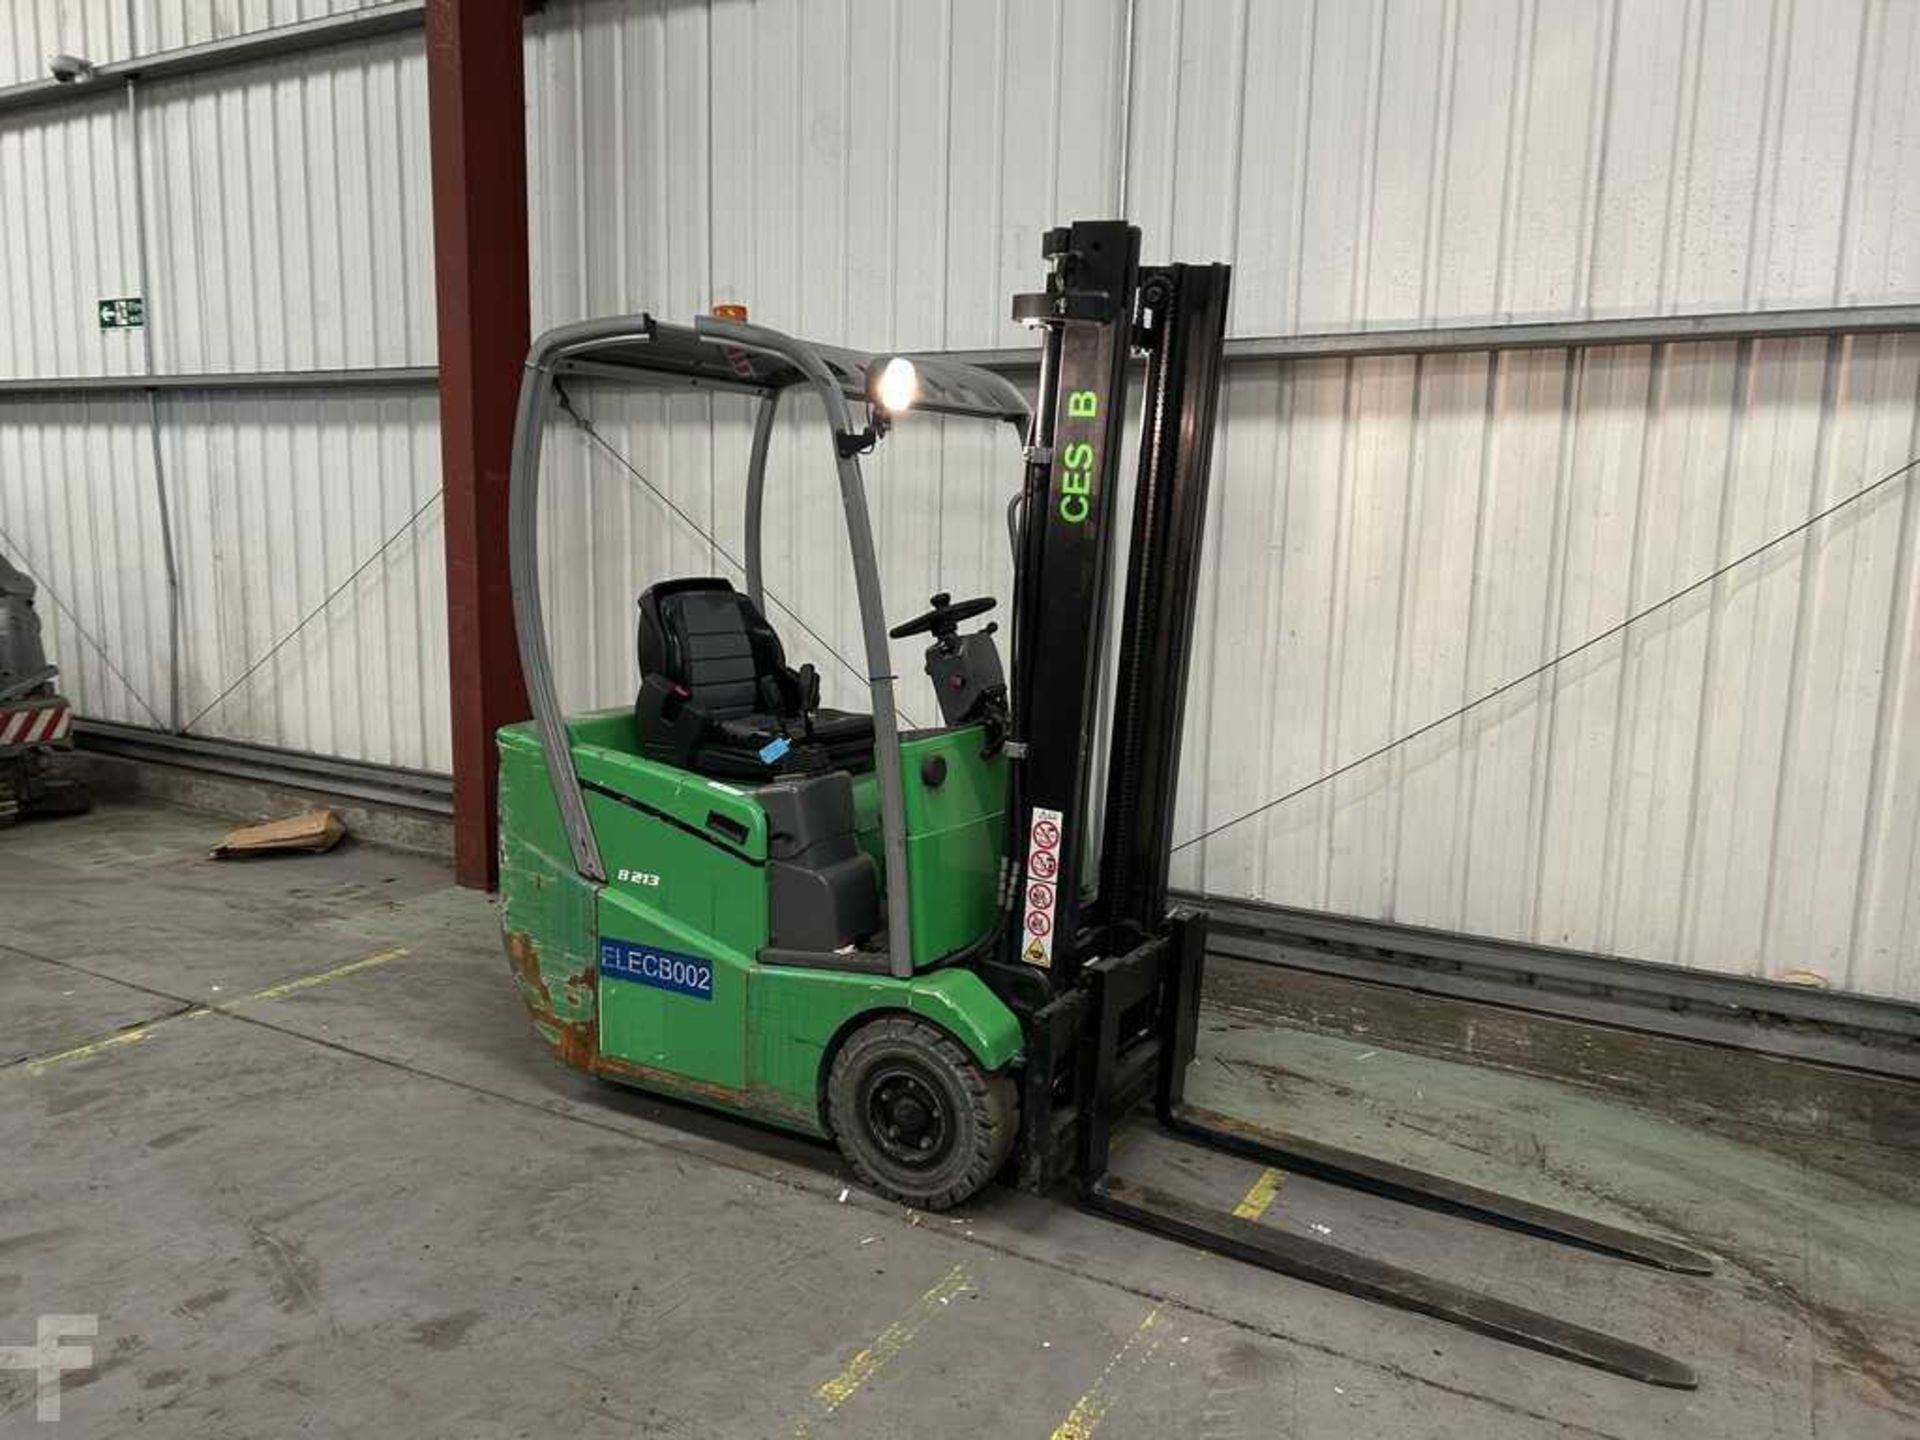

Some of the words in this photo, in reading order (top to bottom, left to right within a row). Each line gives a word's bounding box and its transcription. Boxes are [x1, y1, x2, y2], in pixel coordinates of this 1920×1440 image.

[1068, 391, 1098, 417] B
[1060, 443, 1094, 523] CES
[631, 871, 661, 887] 213
[601, 946, 711, 991] ELECB002
